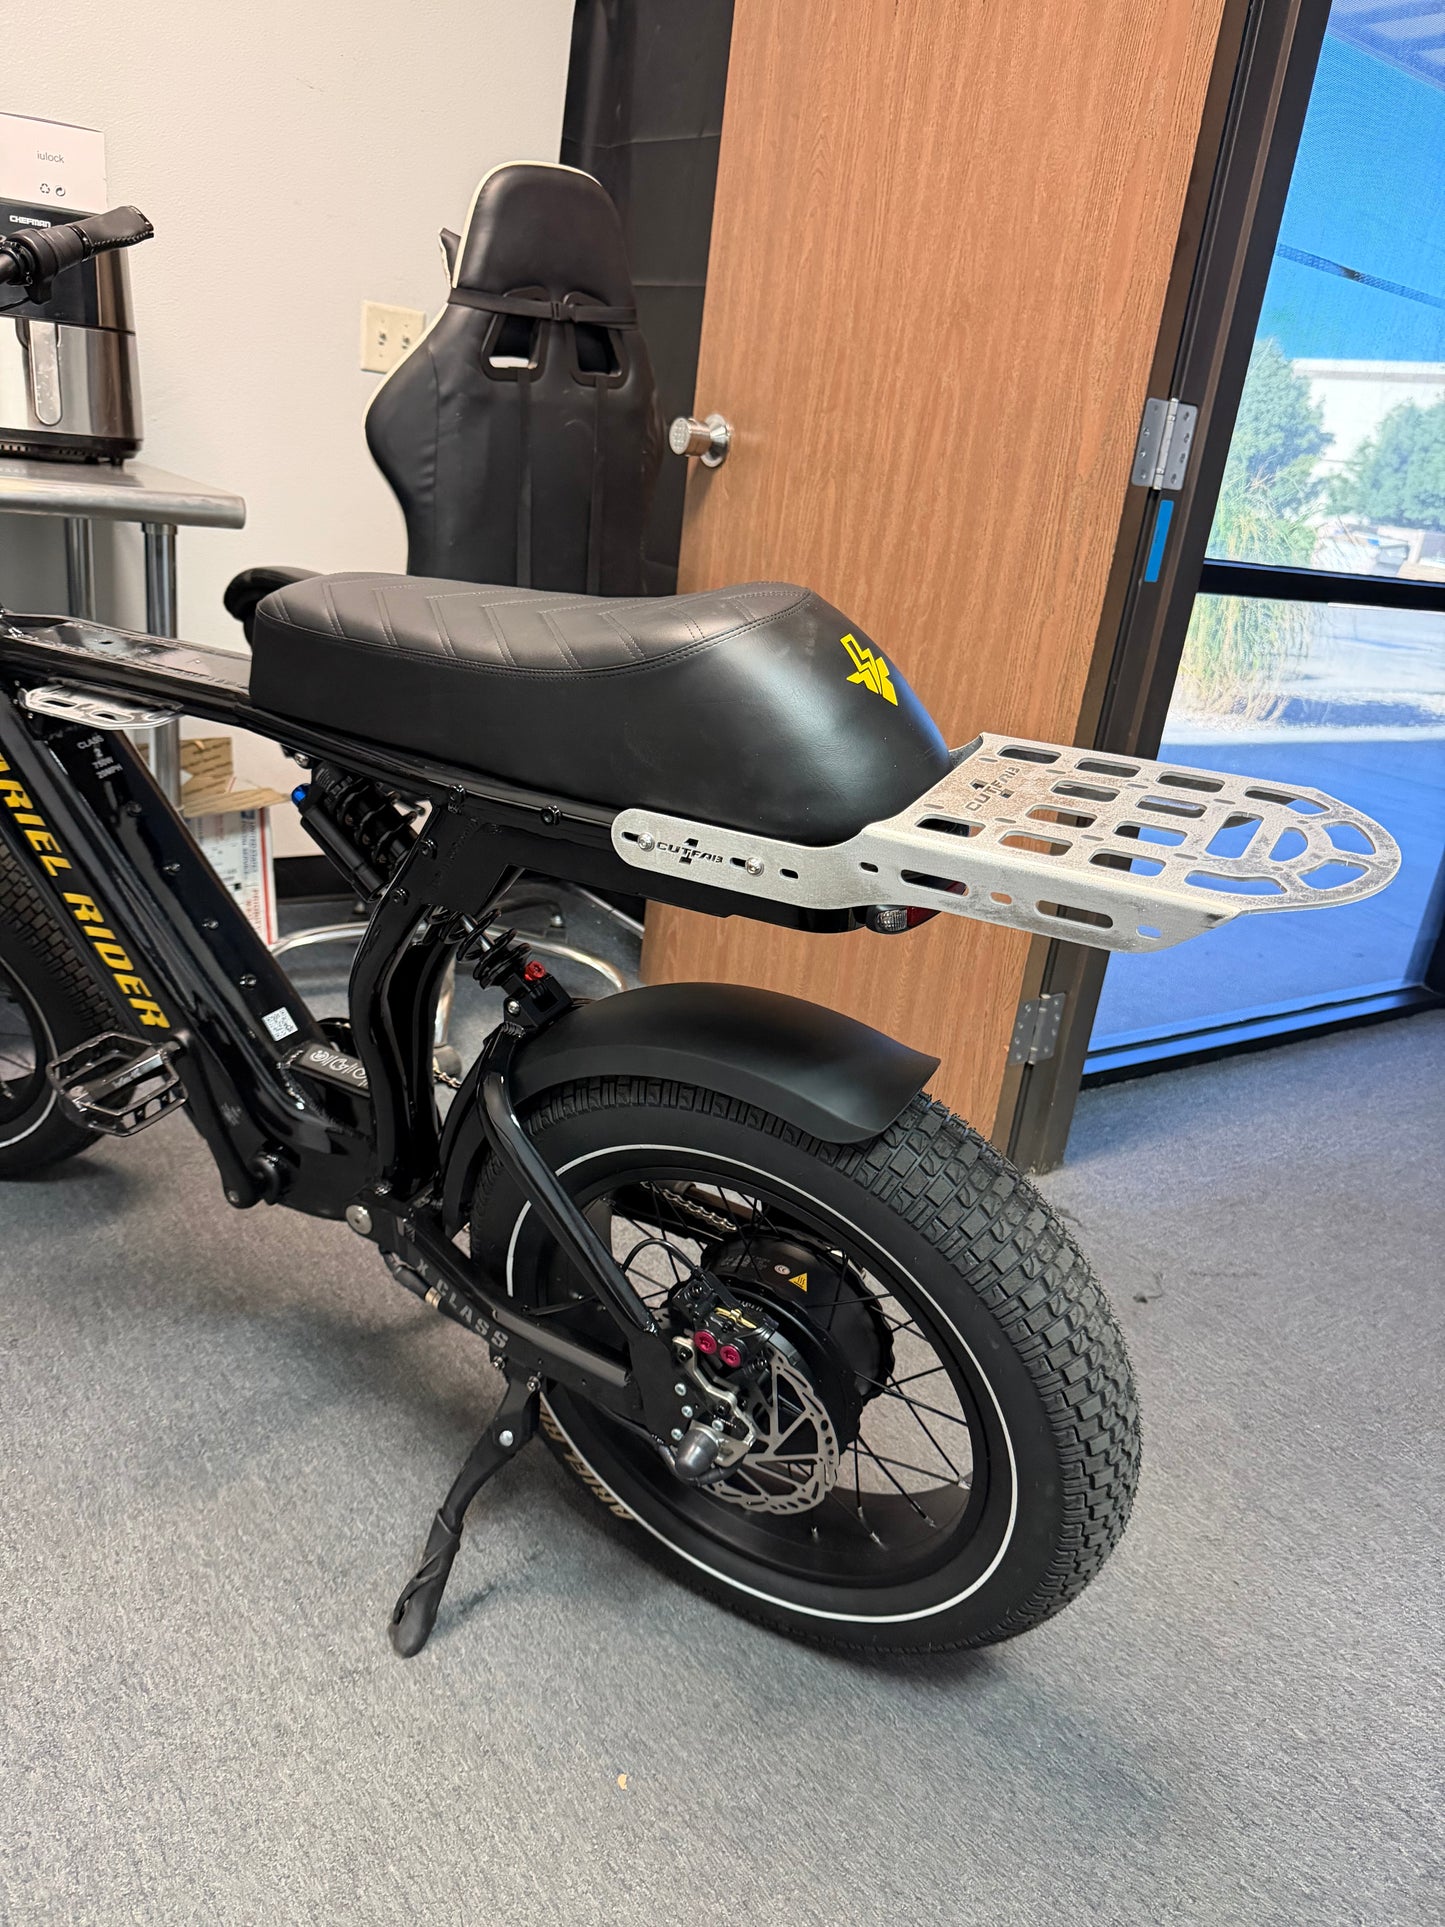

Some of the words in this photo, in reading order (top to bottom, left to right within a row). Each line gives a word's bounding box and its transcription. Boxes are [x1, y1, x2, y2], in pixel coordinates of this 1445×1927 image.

[36, 150, 65, 164] iulock
[9, 215, 51, 228] CHEFMAN
[77, 734, 104, 749] CLASS
[965, 766, 1020, 811] CUTFAB
[656, 840, 724, 863] CUTFAB
[62, 892, 170, 1029] RIDER
[416, 1258, 429, 1277] X
[435, 1278, 509, 1349] CLASS
[563, 1449, 636, 1520] ARIEL
